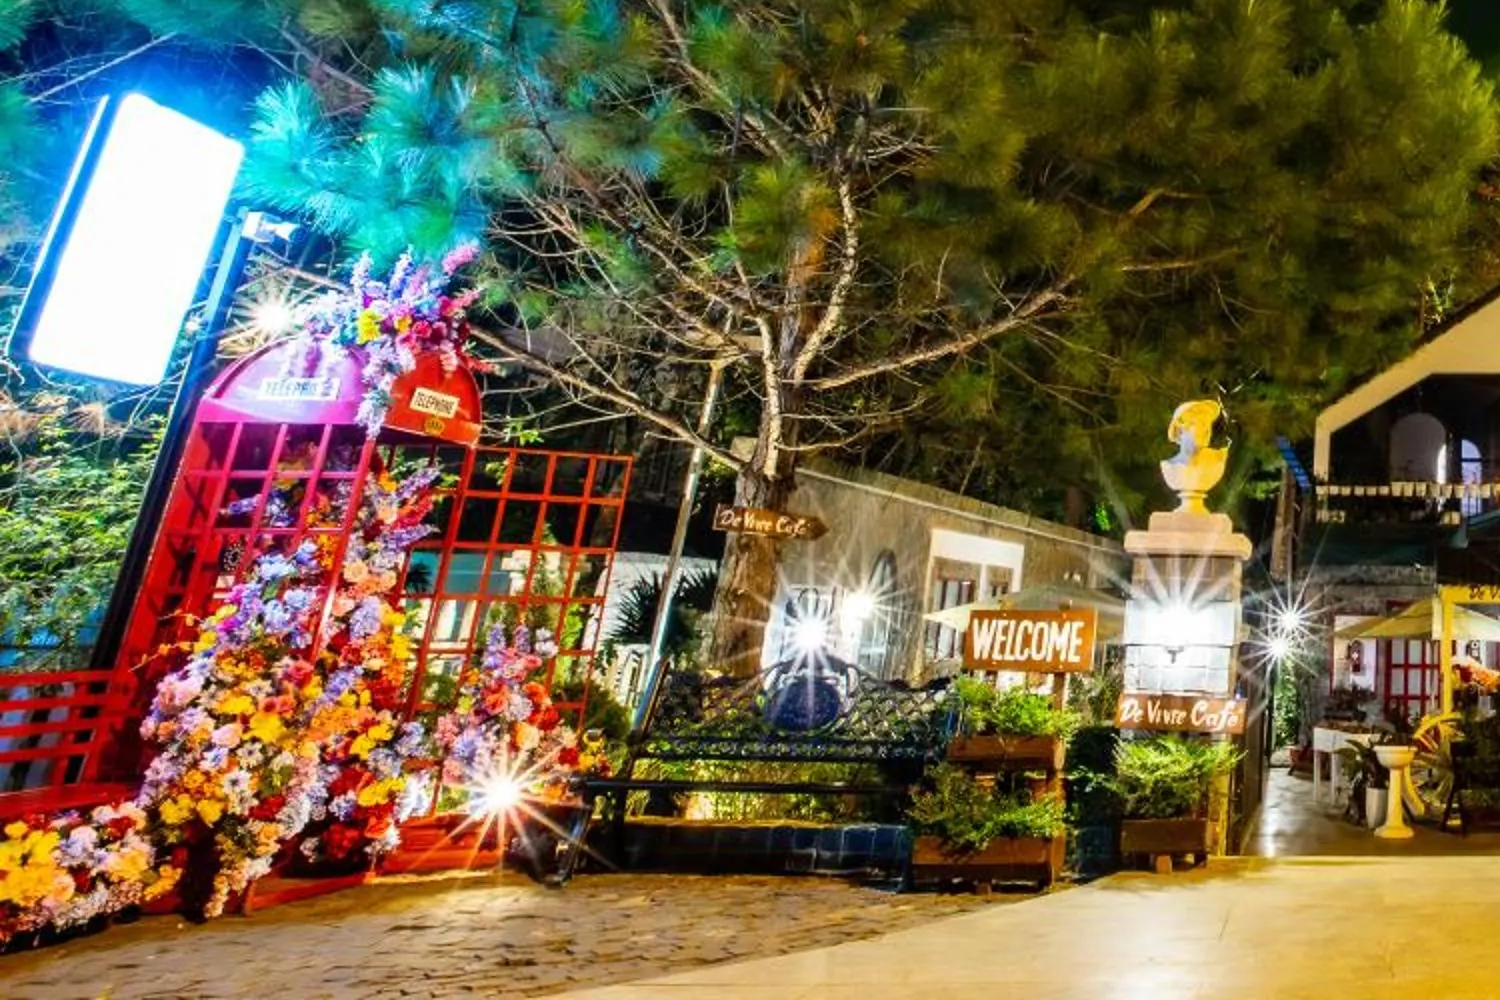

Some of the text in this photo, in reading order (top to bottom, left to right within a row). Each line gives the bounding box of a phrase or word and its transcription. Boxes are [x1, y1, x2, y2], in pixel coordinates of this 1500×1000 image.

[720, 509, 743, 527] De
[972, 617, 1086, 663] WELCOME
[1118, 698, 1145, 723] De
